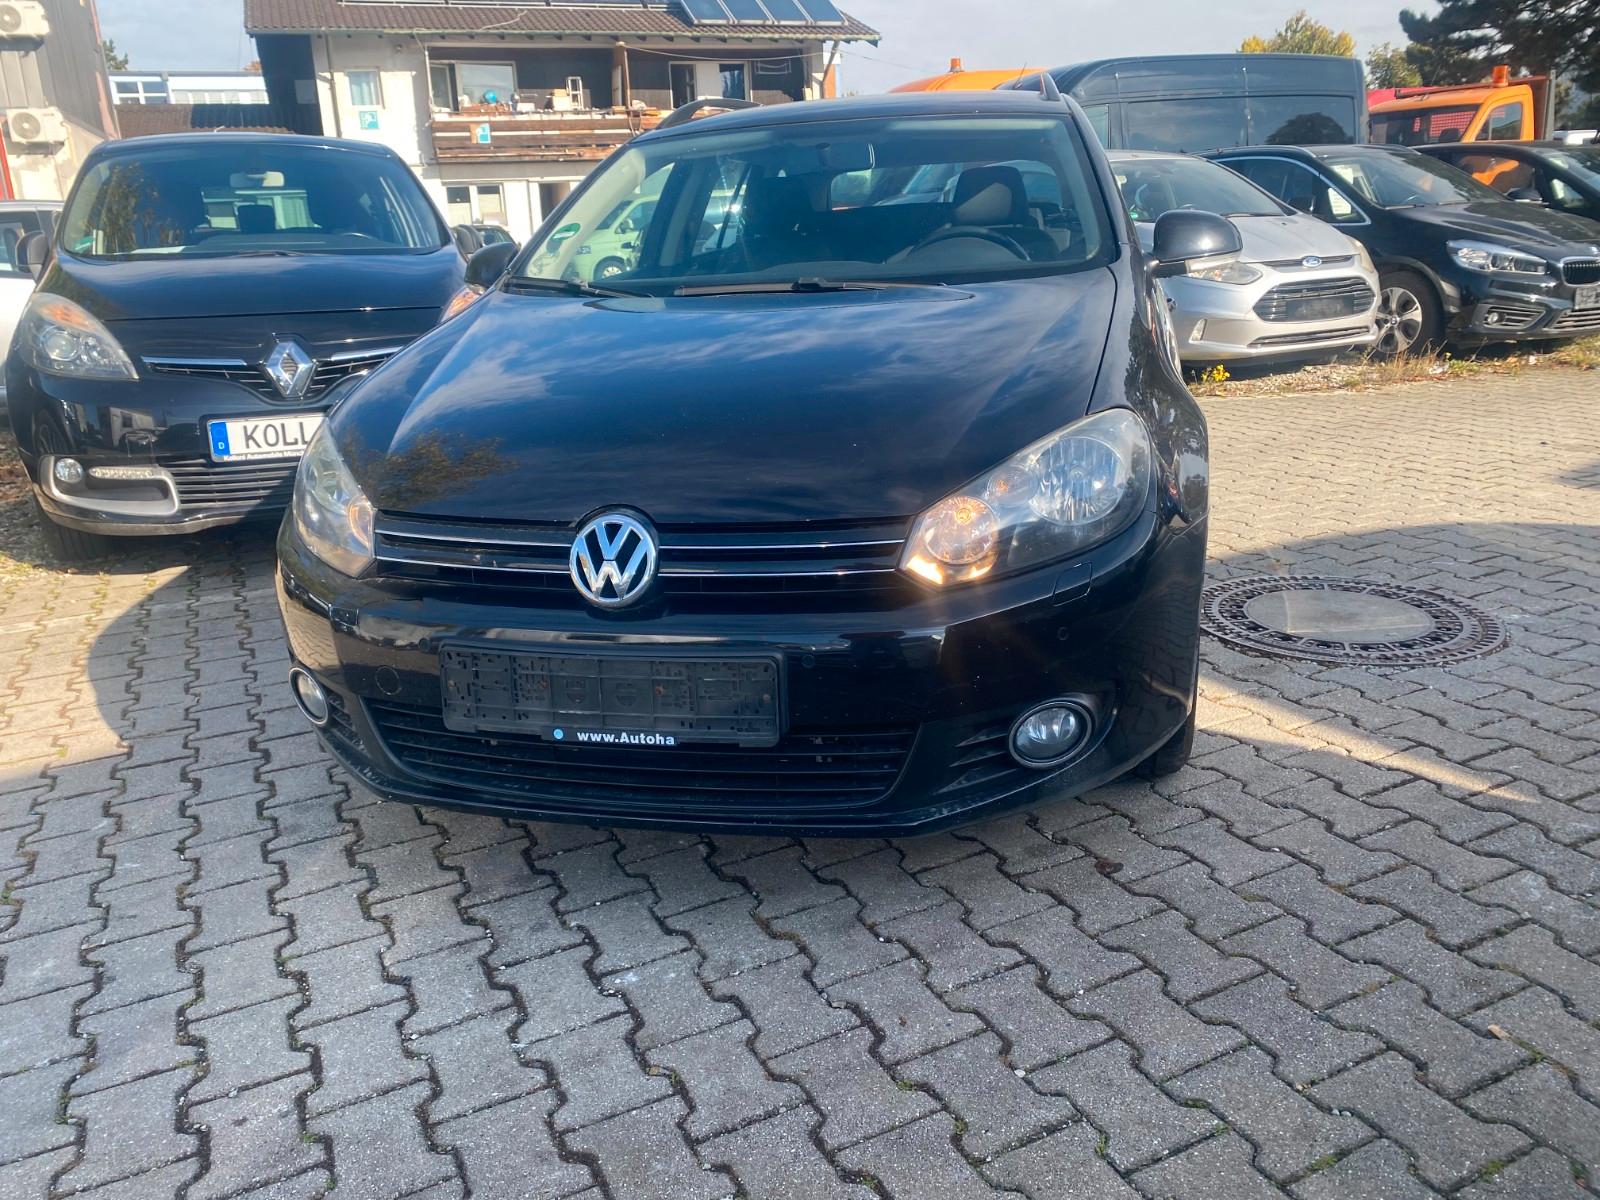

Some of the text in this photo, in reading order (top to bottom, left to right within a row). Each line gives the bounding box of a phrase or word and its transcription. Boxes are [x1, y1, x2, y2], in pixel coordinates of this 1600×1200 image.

[243, 421, 309, 449] KOLL
[218, 442, 225, 450] D
[576, 731, 676, 746] www.Autoha
